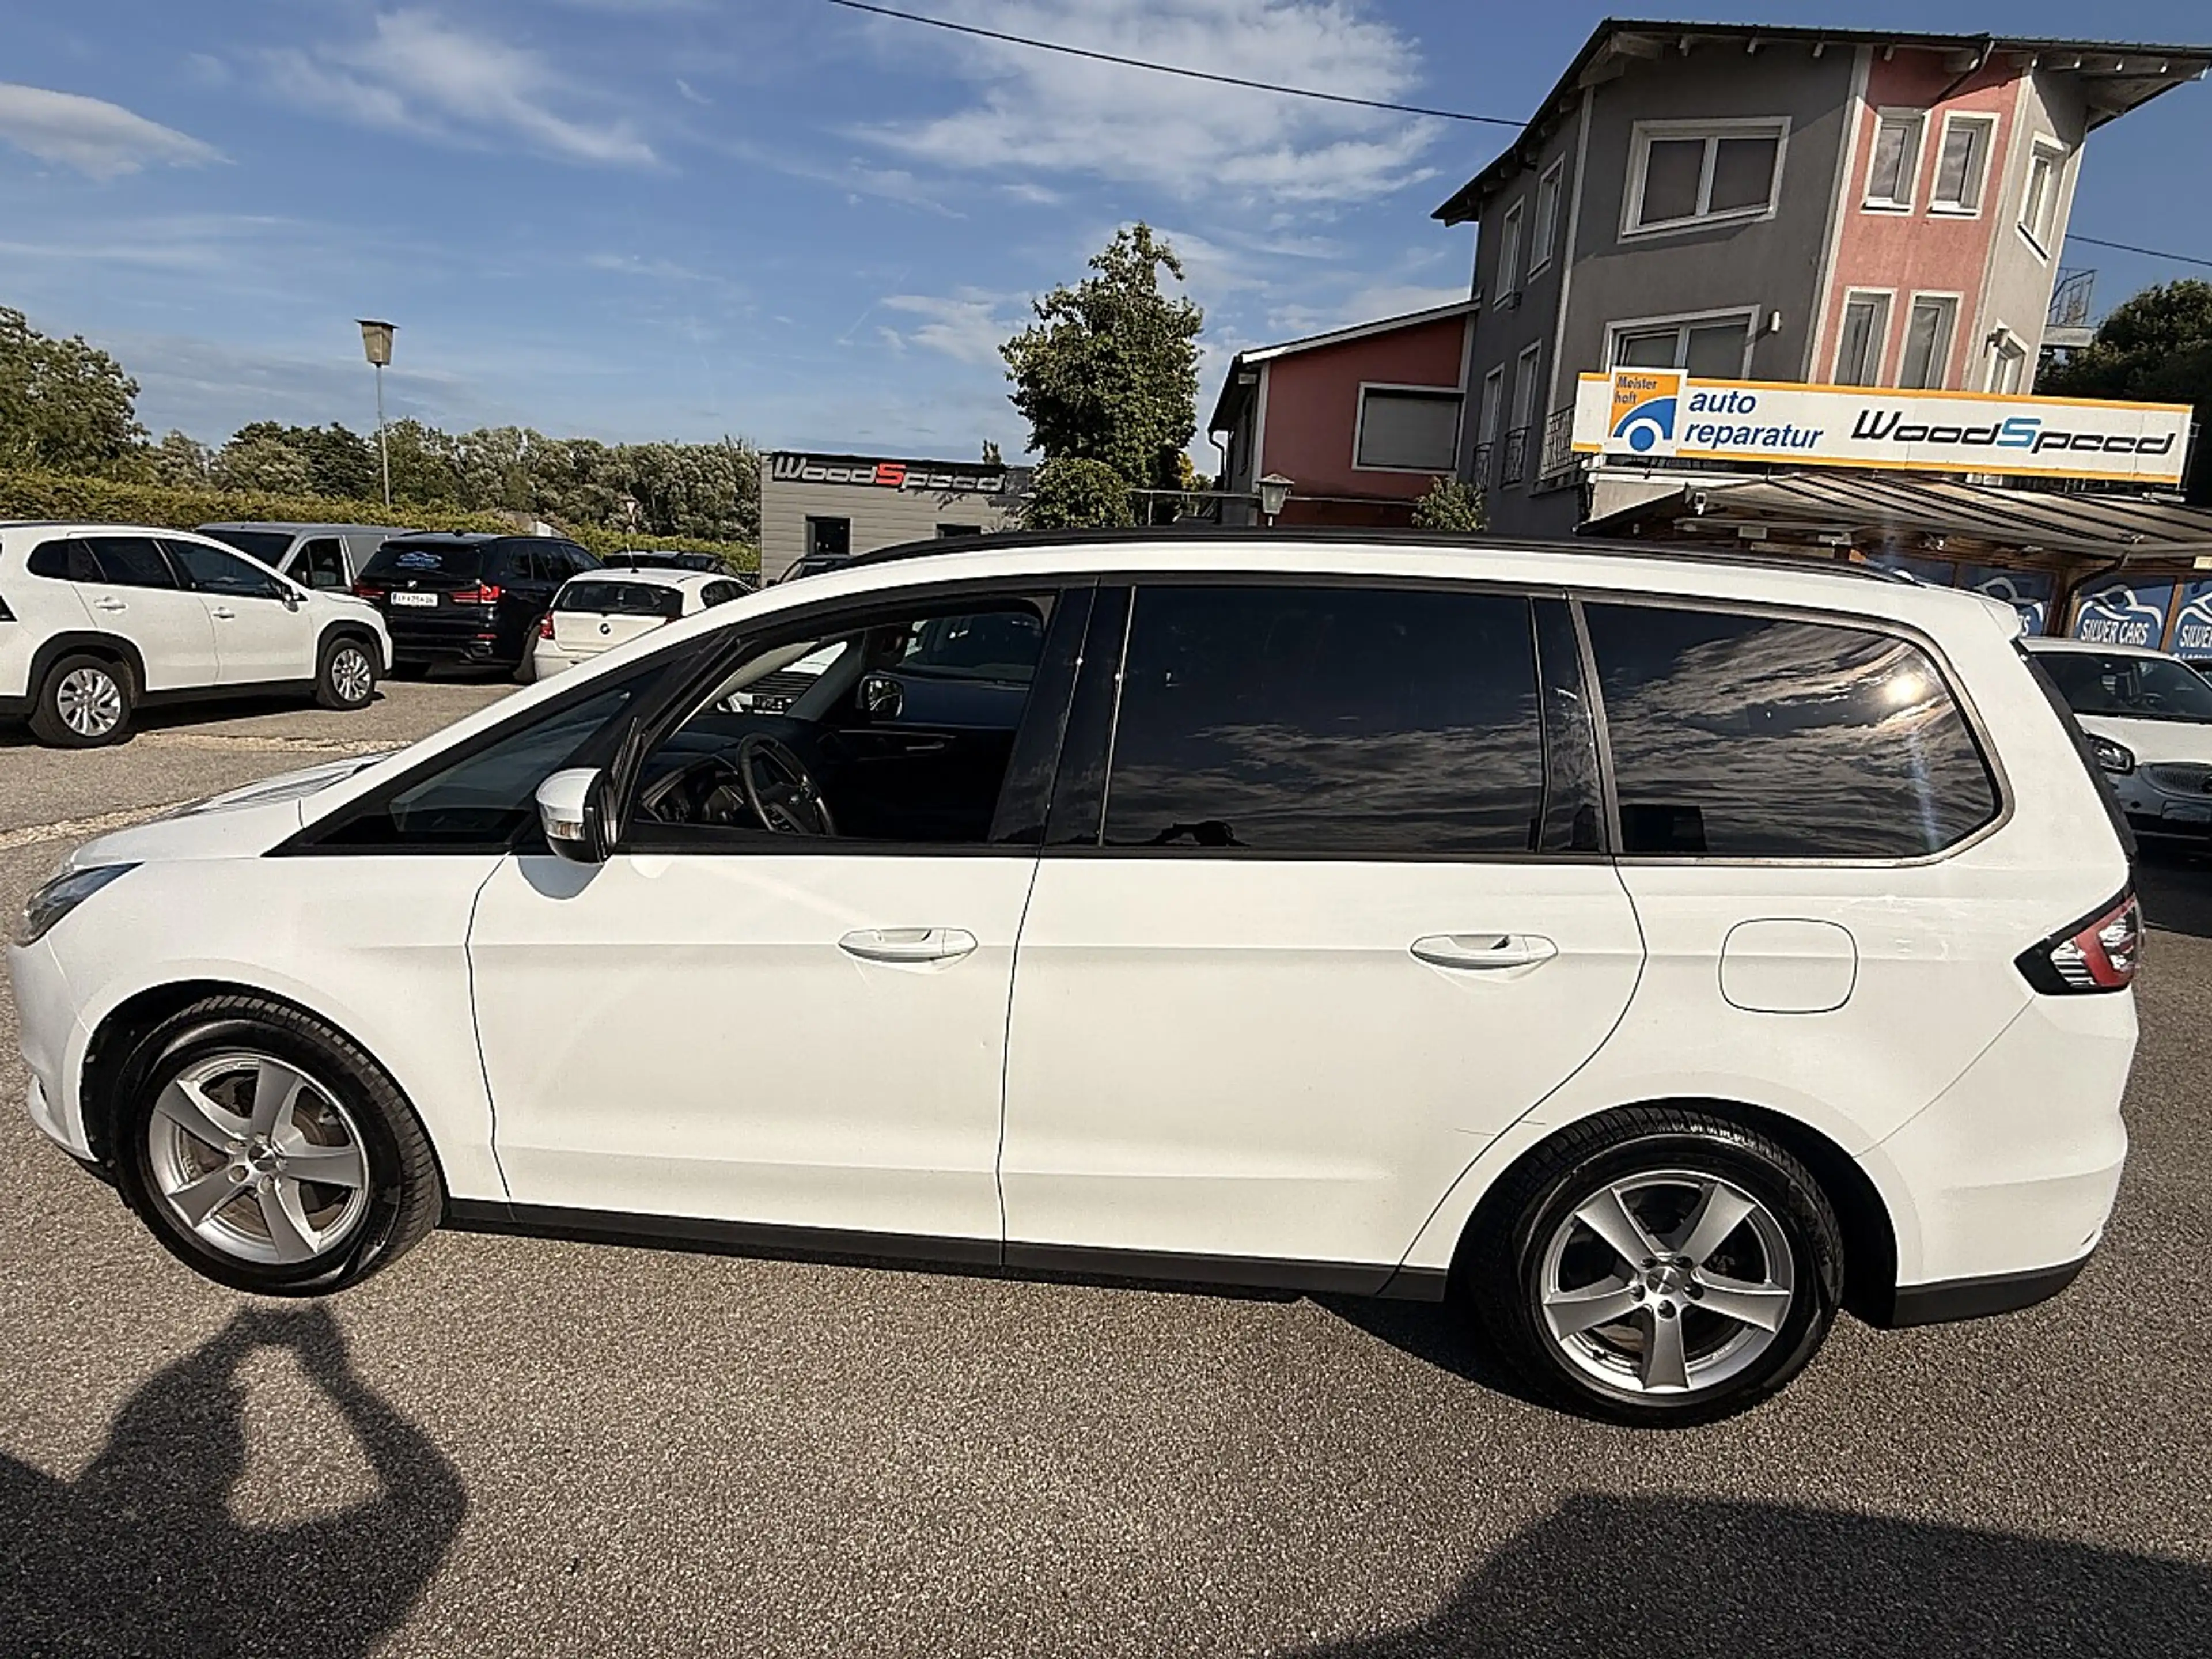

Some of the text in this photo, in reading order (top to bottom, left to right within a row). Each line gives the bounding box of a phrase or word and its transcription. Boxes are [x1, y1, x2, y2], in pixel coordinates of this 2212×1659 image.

[1616, 376, 1657, 389] Meister
[1688, 391, 1757, 414] auto
[1684, 423, 1824, 449] reparatur
[2119, 622, 2149, 646] CARS
